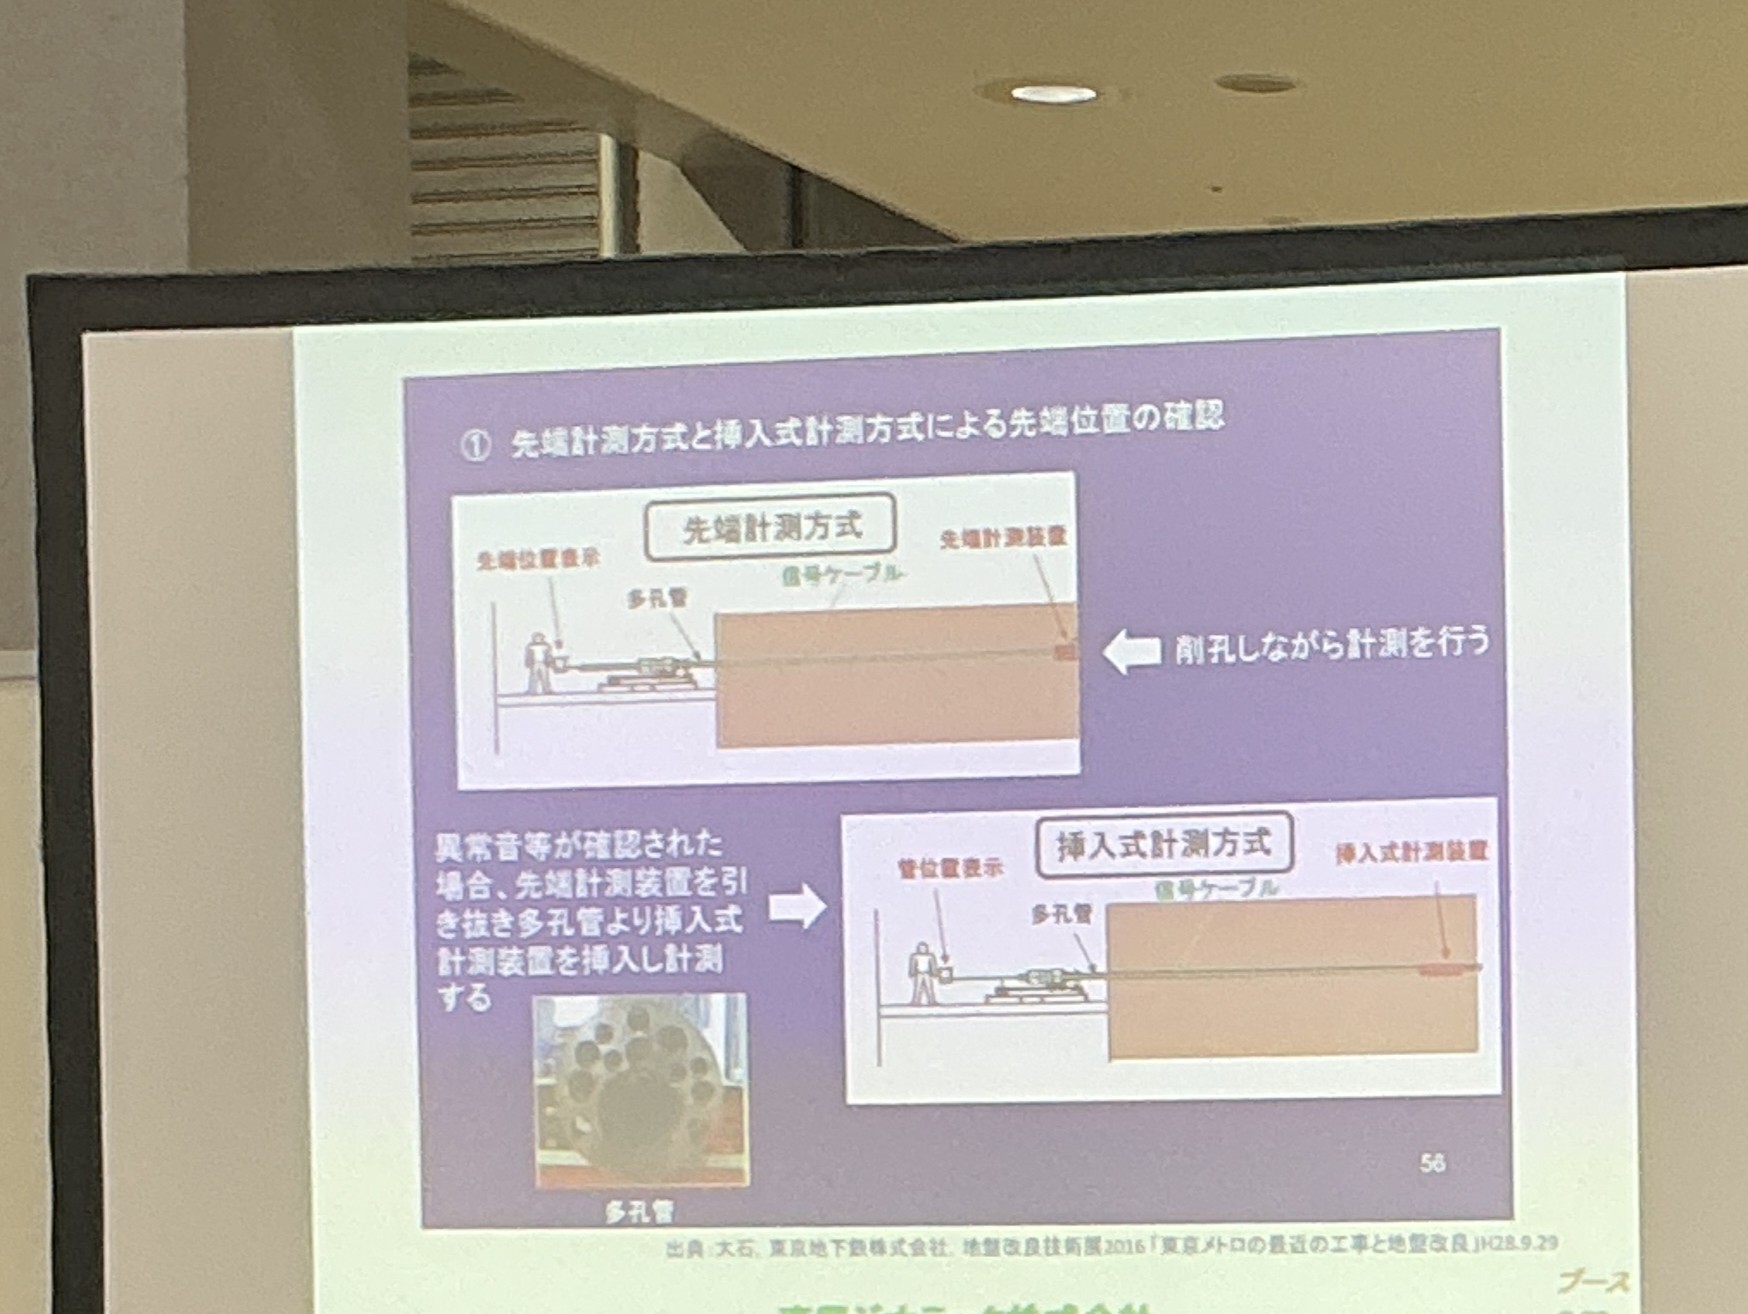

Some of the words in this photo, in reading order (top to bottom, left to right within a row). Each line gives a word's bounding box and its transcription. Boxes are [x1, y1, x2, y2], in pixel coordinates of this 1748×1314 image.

[511, 399, 1227, 459] 先端計測方式と挿入式計測方式による先端位置の確認
[683, 509, 863, 546] 先端計測方式
[940, 524, 1068, 550] 先端計測装置
[476, 547, 601, 571] 先端位置表示
[782, 562, 904, 587] 信号ケーブル
[627, 587, 688, 610] 多孔管
[1176, 624, 1489, 665] 削孔しながら計測を行う
[435, 828, 723, 862] 異常音等が確認された
[1057, 826, 1272, 862] 挿入式計測方式
[1336, 839, 1489, 865] 挿入式計測装置
[898, 857, 1004, 880] 管位置表示
[436, 866, 747, 901] 場合、先端計測装置を引
[1155, 877, 1279, 901] 信号ケーブル
[436, 904, 743, 938] き抜き多孔管より挿入式
[1032, 903, 1093, 925] 多孔管
[437, 943, 724, 976] 計測装置を挿入し計測
[437, 982, 492, 1012] する
[606, 1199, 674, 1224] 多孔管
[1557, 1267, 1631, 1294] ブース
